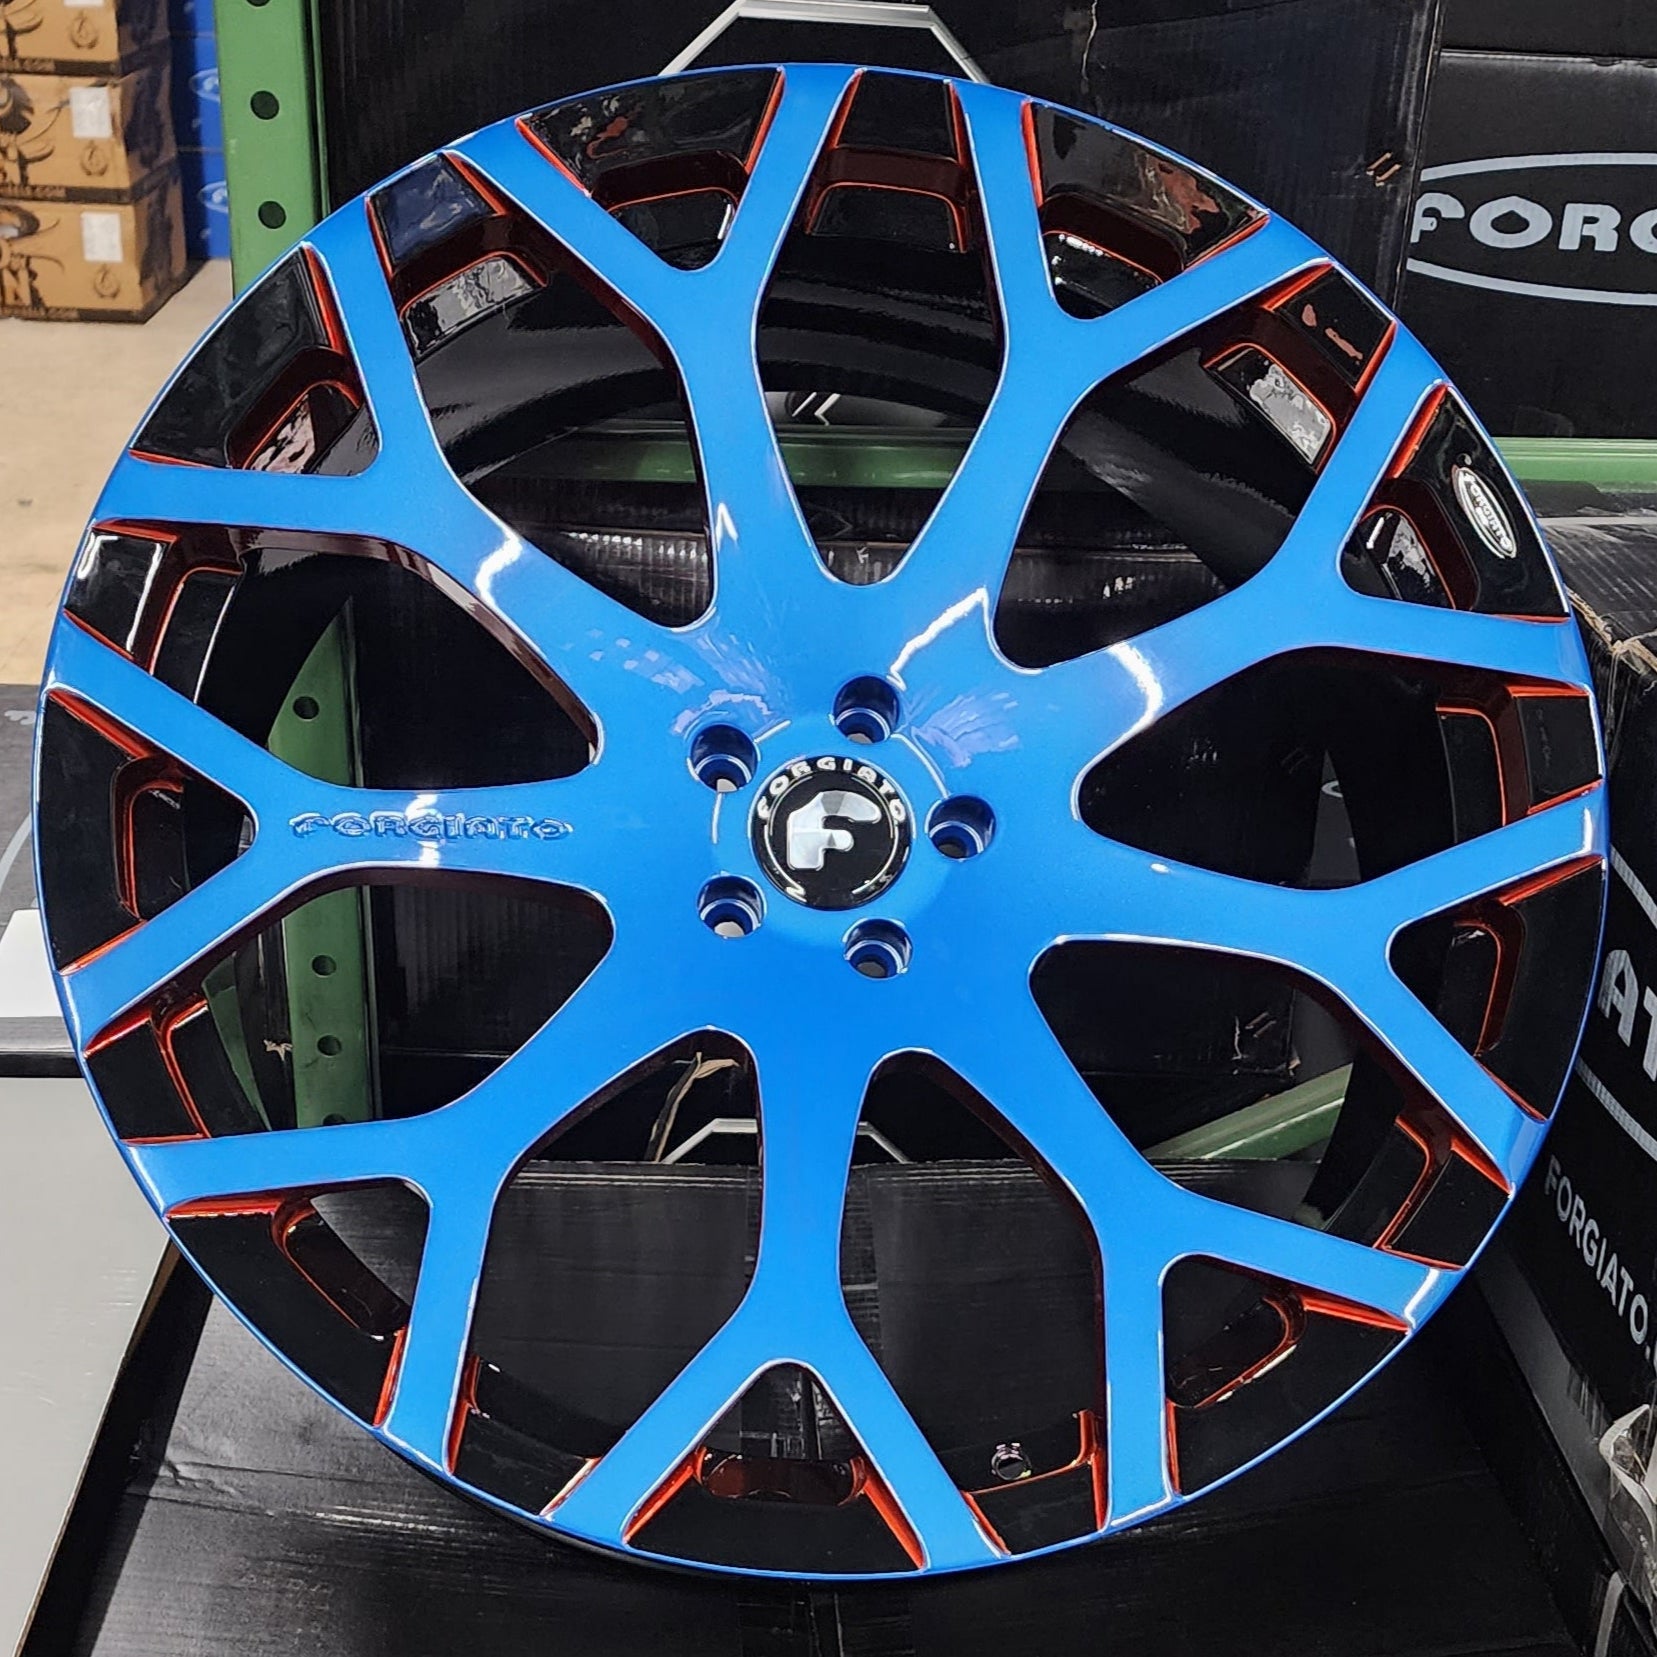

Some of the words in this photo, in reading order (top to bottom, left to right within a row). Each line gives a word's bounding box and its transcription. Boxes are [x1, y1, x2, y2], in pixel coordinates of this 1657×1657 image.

[757, 756, 906, 822] FORGIATO
[290, 811, 573, 840] FORGIATO
[1544, 1154, 1657, 1378] FORGIATO.
